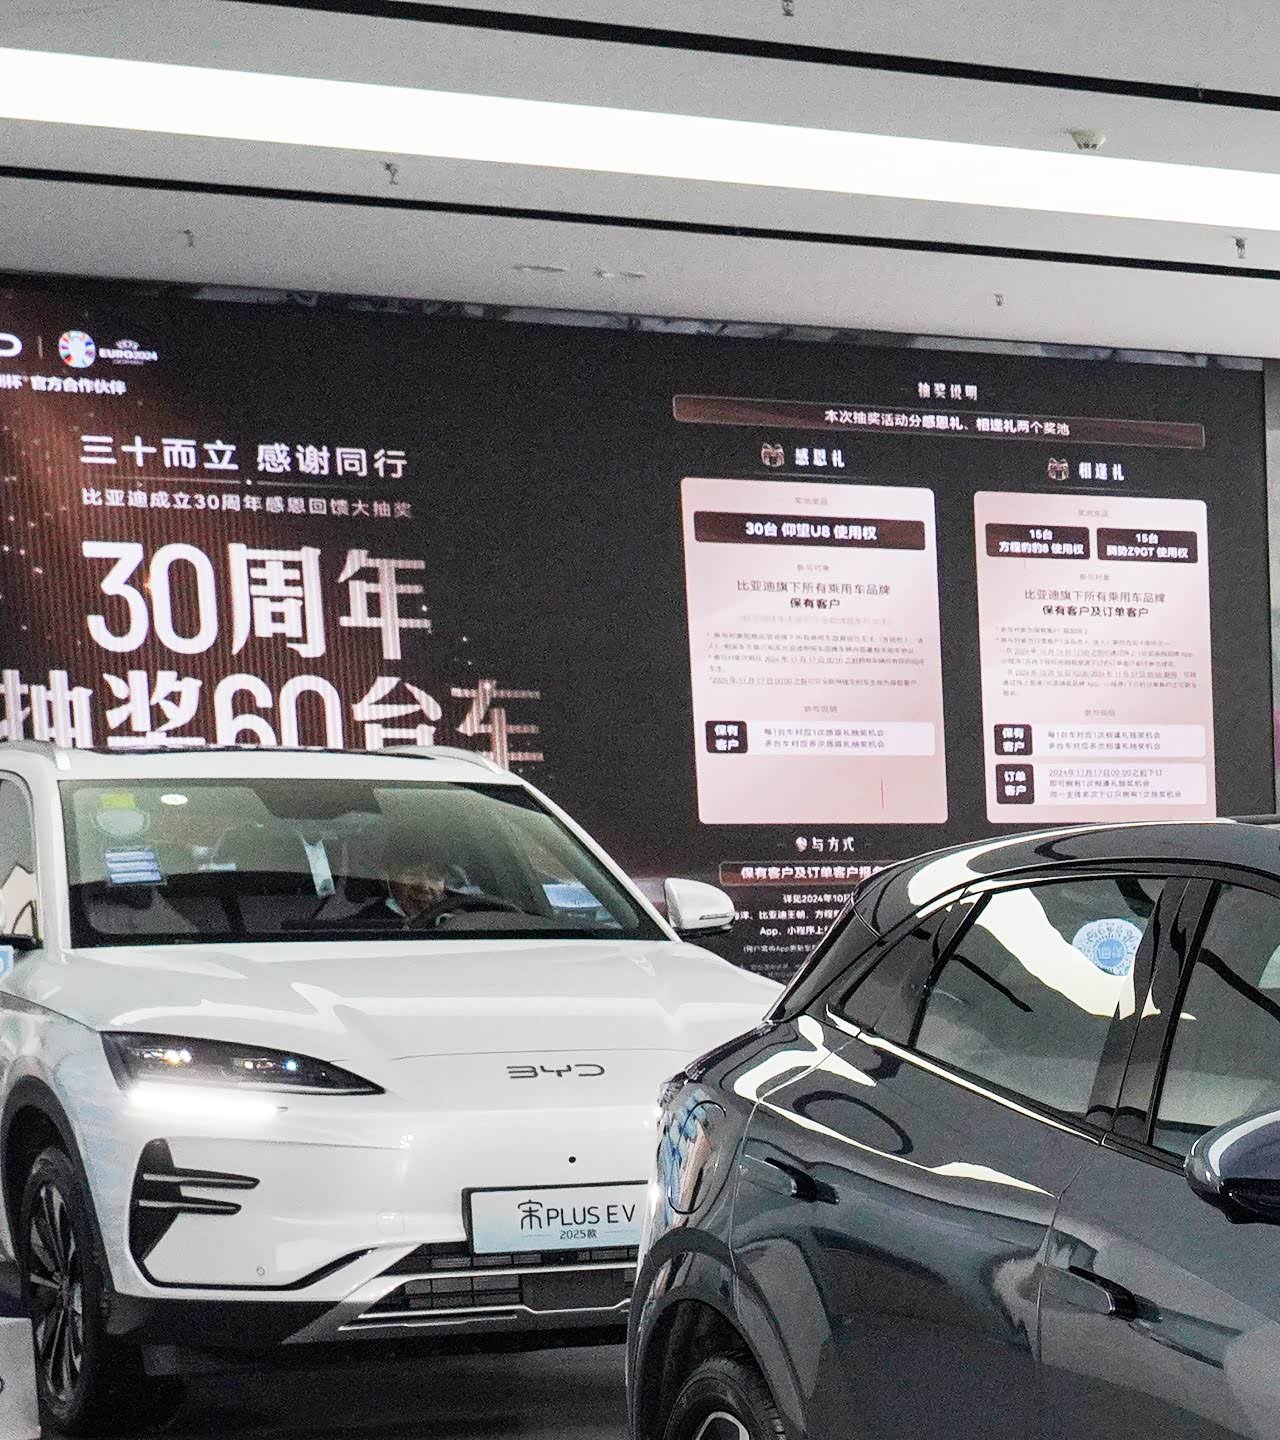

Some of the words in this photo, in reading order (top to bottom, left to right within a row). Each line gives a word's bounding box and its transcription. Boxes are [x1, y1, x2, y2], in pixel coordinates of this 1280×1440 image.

[80, 434, 240, 472] 三十而立
[256, 441, 408, 479] 感谢同行
[794, 447, 846, 468] 感恩礼
[1078, 461, 1125, 482] 相逢礼
[80, 487, 412, 519] 比亚迪成立30周年感恩回馈大抽奖
[745, 520, 778, 538] 30台
[833, 524, 878, 542] 使用权
[81, 540, 433, 661] 30周年
[506, 1063, 606, 1080] BYD
[607, 1204, 636, 1224] EV
[559, 1228, 598, 1240] 2025款
